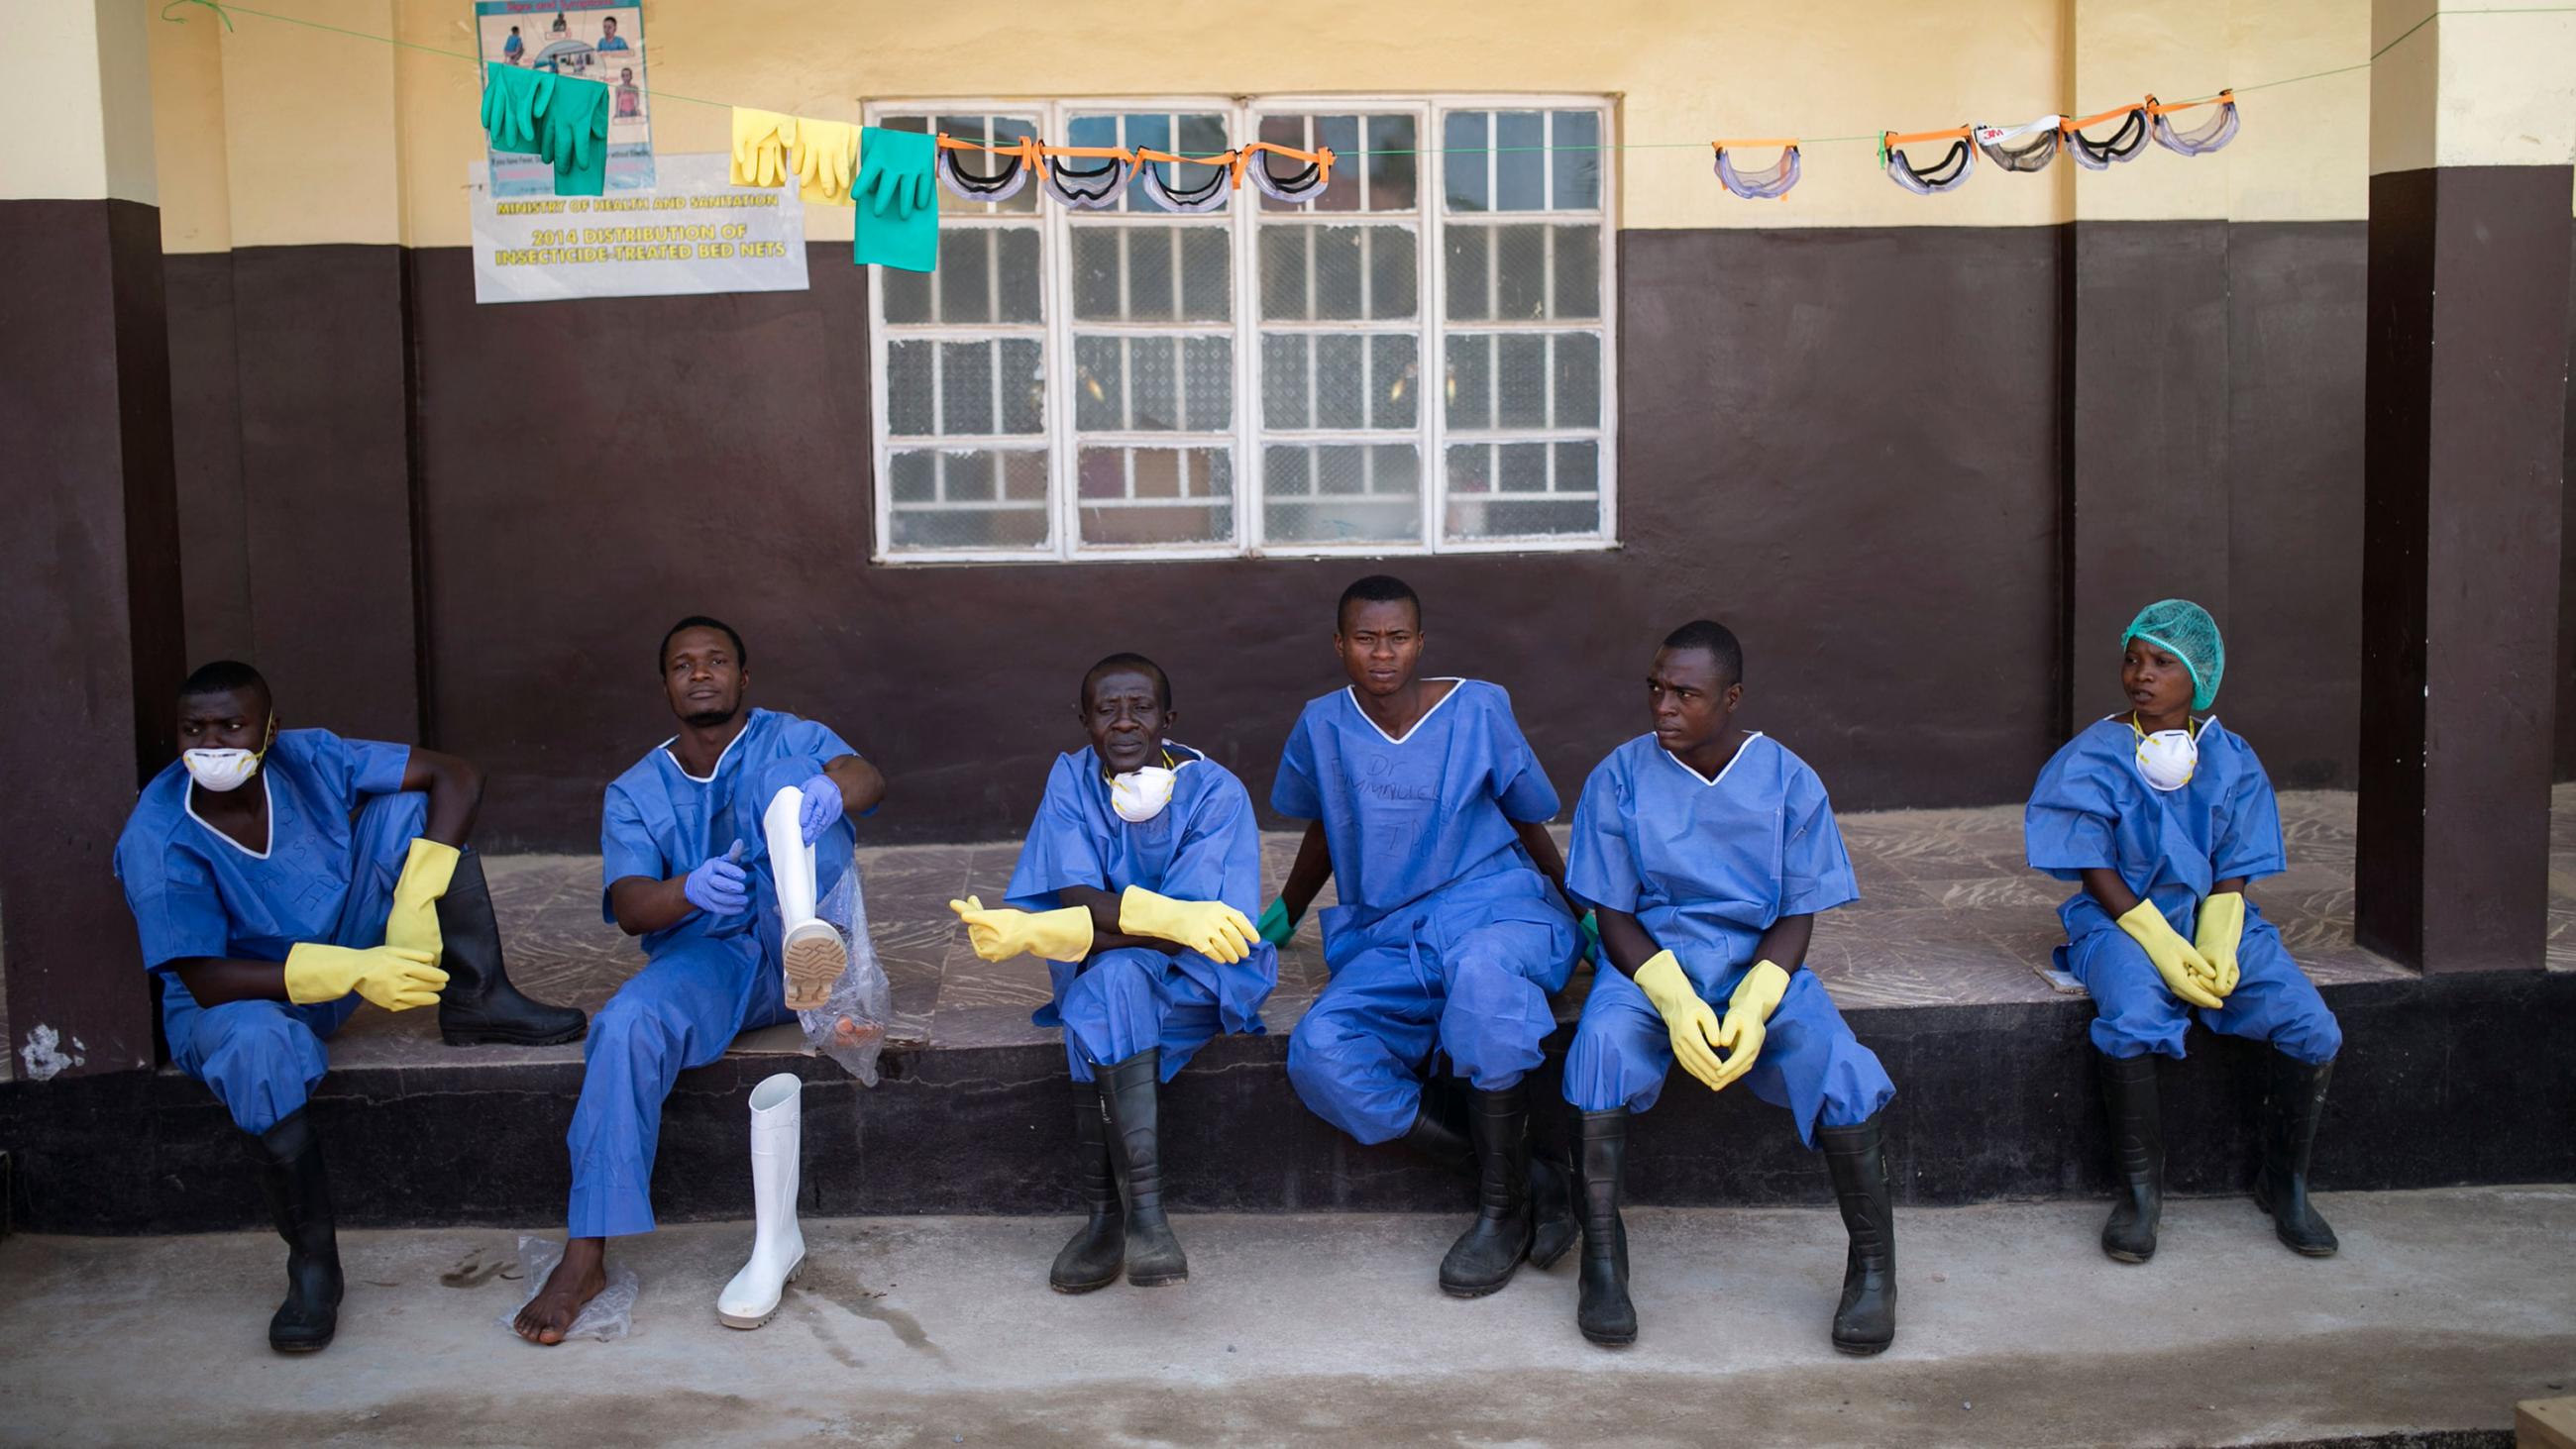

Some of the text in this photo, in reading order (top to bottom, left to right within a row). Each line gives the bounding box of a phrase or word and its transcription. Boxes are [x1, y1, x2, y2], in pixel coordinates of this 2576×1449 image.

[1983, 129, 2004, 140] 3M
[496, 194, 780, 215] MINISTRY OF HEALTH AND SANITATION
[531, 224, 748, 247] 2014 DISTRIBUTION OF
[494, 241, 787, 266] INSECTICIDE-TREATED BED NETS
